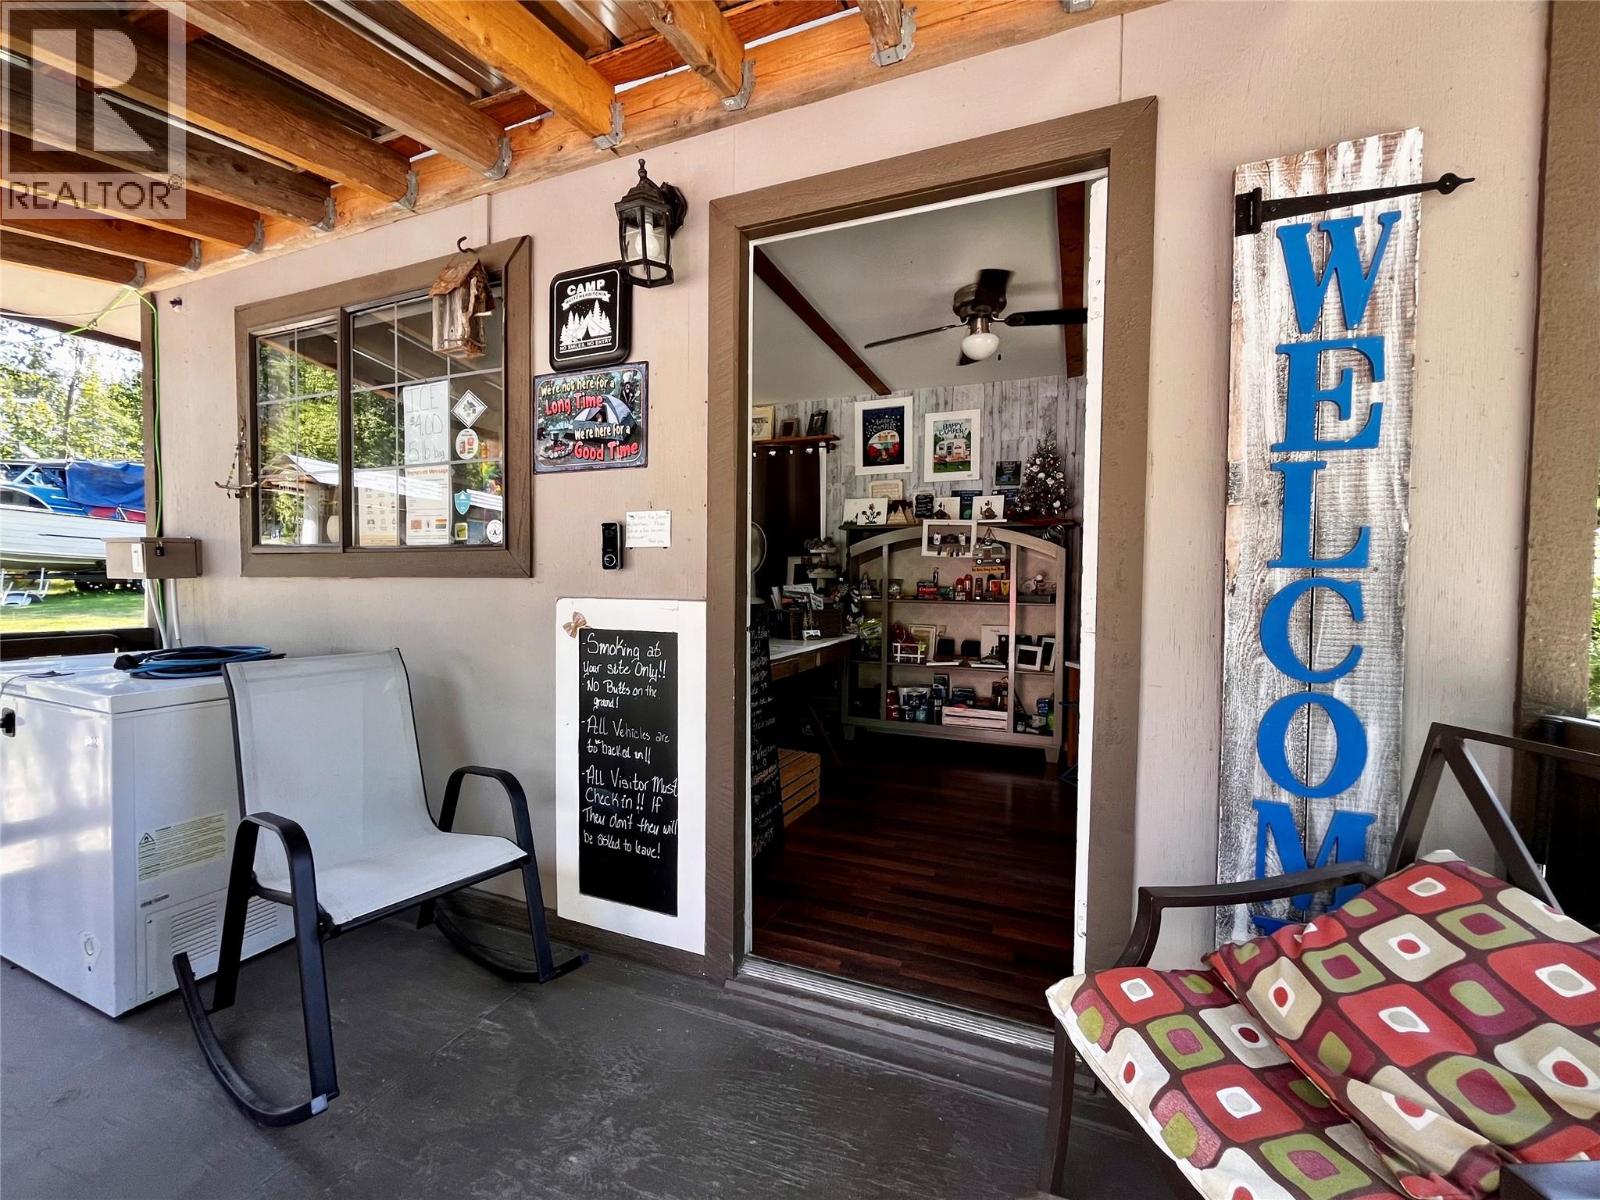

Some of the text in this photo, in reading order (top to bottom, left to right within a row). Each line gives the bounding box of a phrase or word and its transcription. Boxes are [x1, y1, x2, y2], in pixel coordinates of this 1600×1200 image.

[566, 278, 606, 296] CAMP
[595, 337, 612, 346] ENTRY
[541, 384, 561, 396] We're
[562, 381, 575, 393] not
[577, 378, 594, 390] here
[595, 376, 608, 390] for
[405, 384, 440, 413] ICE
[545, 392, 604, 416] Long Time
[574, 428, 594, 441] We're
[594, 425, 612, 438] here
[612, 423, 624, 436] for
[942, 422, 963, 430] HAPPY
[574, 440, 640, 461] Good Time
[1252, 209, 1402, 937] WELCOM
[646, 640, 662, 658] at
[634, 659, 667, 685] Only!!
[632, 687, 643, 697] on
[644, 684, 657, 698] the
[612, 718, 651, 742] Vehicles
[655, 729, 670, 743] are
[586, 738, 598, 754] to
[601, 739, 631, 758] backed
[610, 767, 649, 791] Visitor
[652, 776, 678, 798] Must
[651, 796, 664, 813] If
[609, 813, 633, 830] don't
[662, 818, 678, 836] will
[583, 829, 593, 843] be
[623, 838, 632, 852] to
[635, 839, 661, 859] leave!
